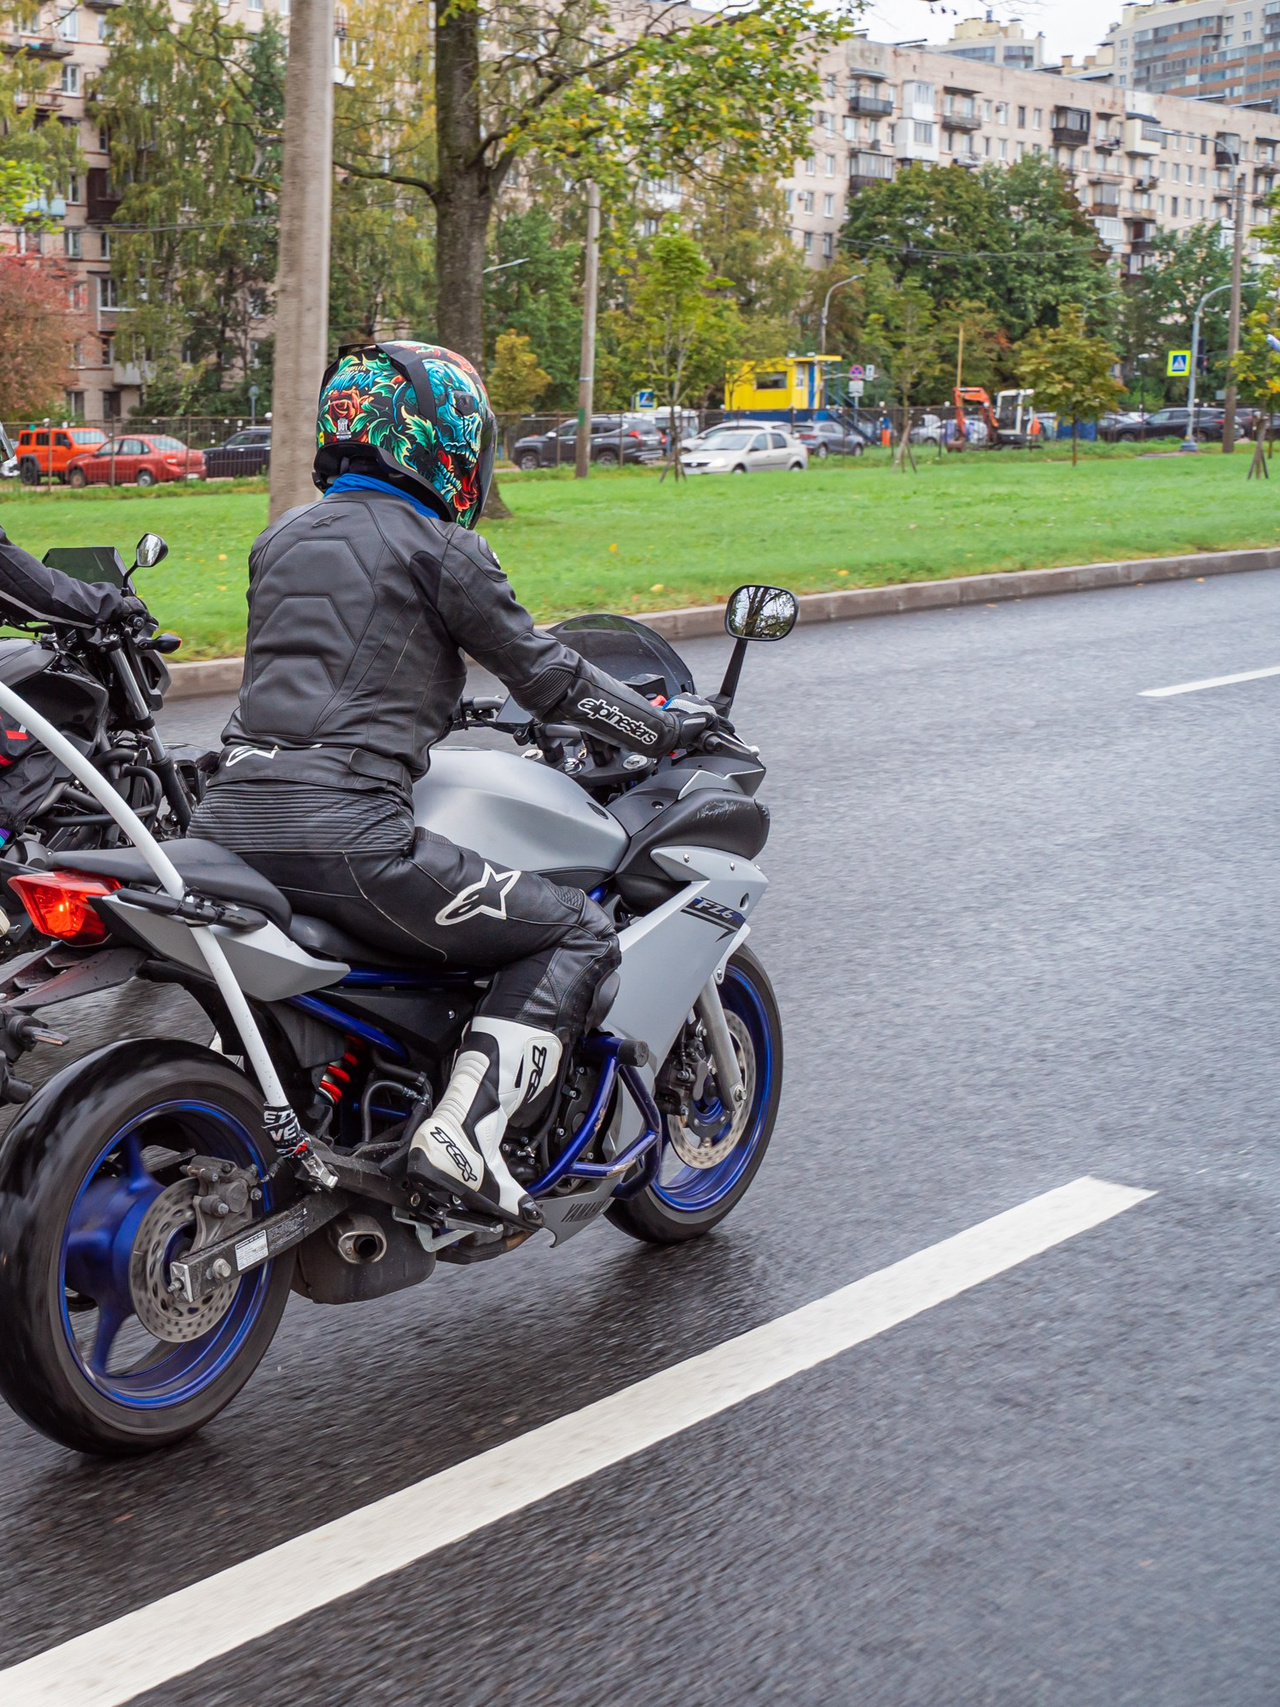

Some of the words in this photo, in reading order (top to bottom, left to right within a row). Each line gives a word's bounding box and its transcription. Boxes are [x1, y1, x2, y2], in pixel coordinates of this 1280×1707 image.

[577, 698, 659, 745] alpinestars
[525, 1045, 547, 1100] TC
[430, 1126, 478, 1182] TCX
